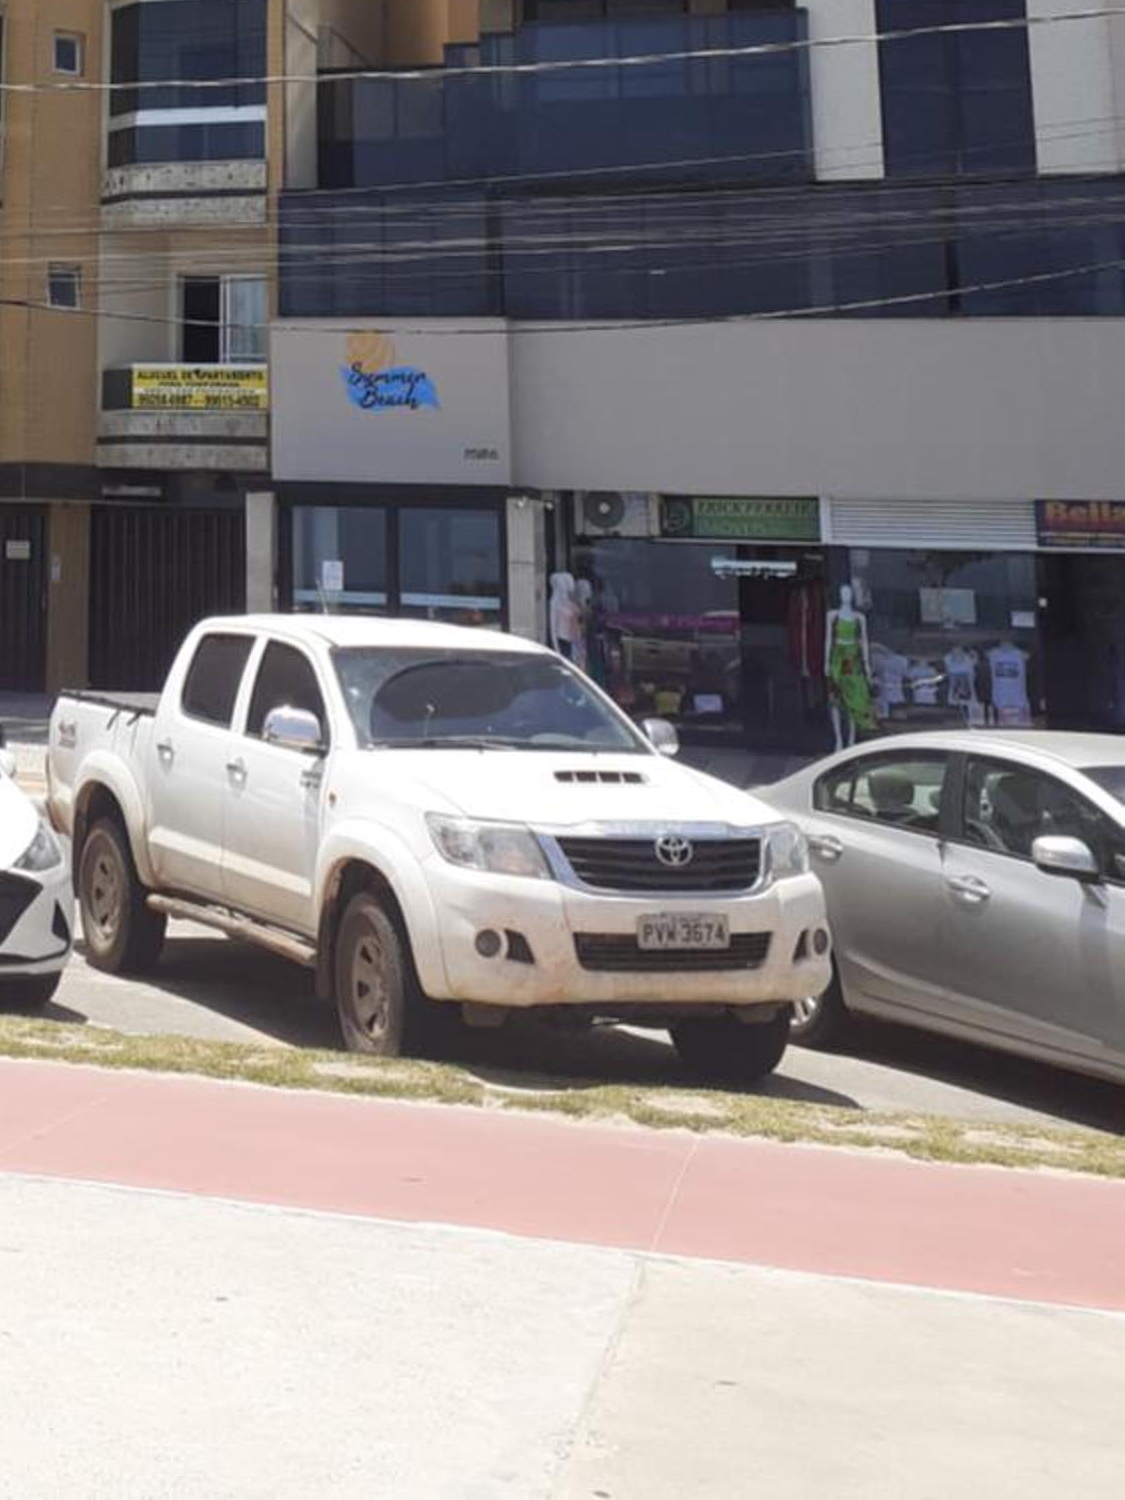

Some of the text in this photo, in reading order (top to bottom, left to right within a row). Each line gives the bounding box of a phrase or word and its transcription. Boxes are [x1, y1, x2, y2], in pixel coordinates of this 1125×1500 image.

[138, 370, 177, 380] ALUGUEL
[348, 361, 427, 387] Summer
[360, 381, 418, 410] Beach
